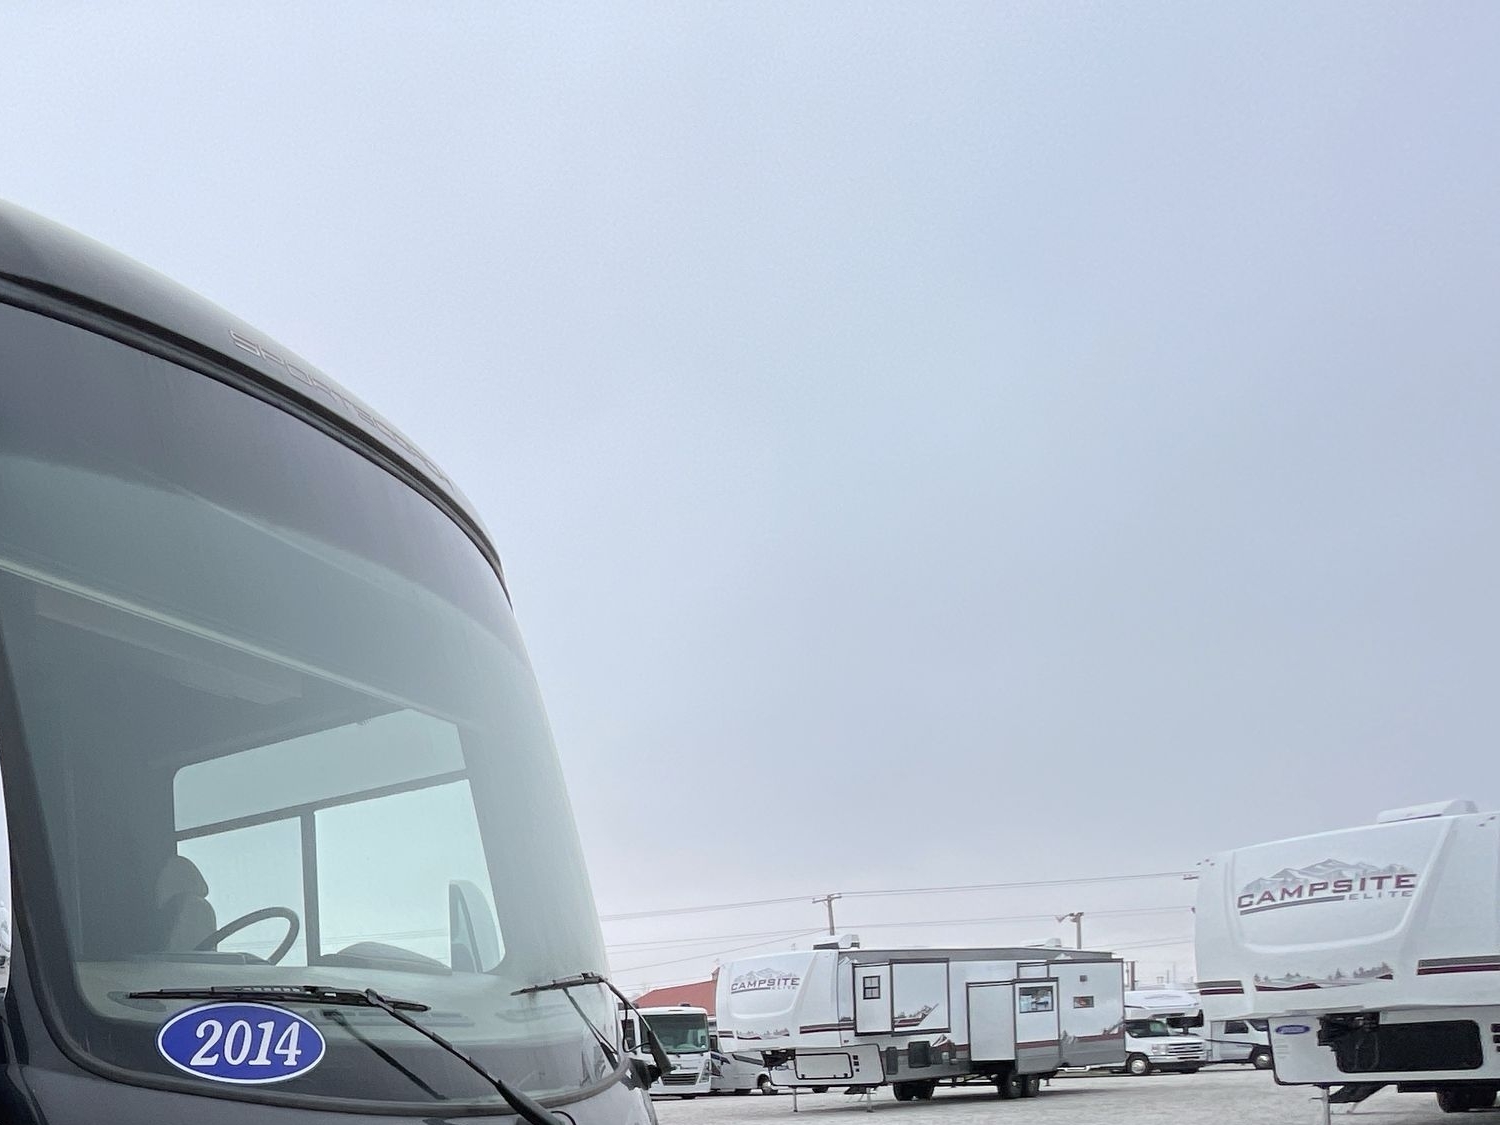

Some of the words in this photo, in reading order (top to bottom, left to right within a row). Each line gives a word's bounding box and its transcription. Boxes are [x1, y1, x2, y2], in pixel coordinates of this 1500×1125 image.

[1237, 873, 1418, 909] CAMPSITE
[1348, 890, 1414, 901] ELITE
[731, 977, 801, 991] CAMPSITE
[190, 1019, 302, 1066] 2014
